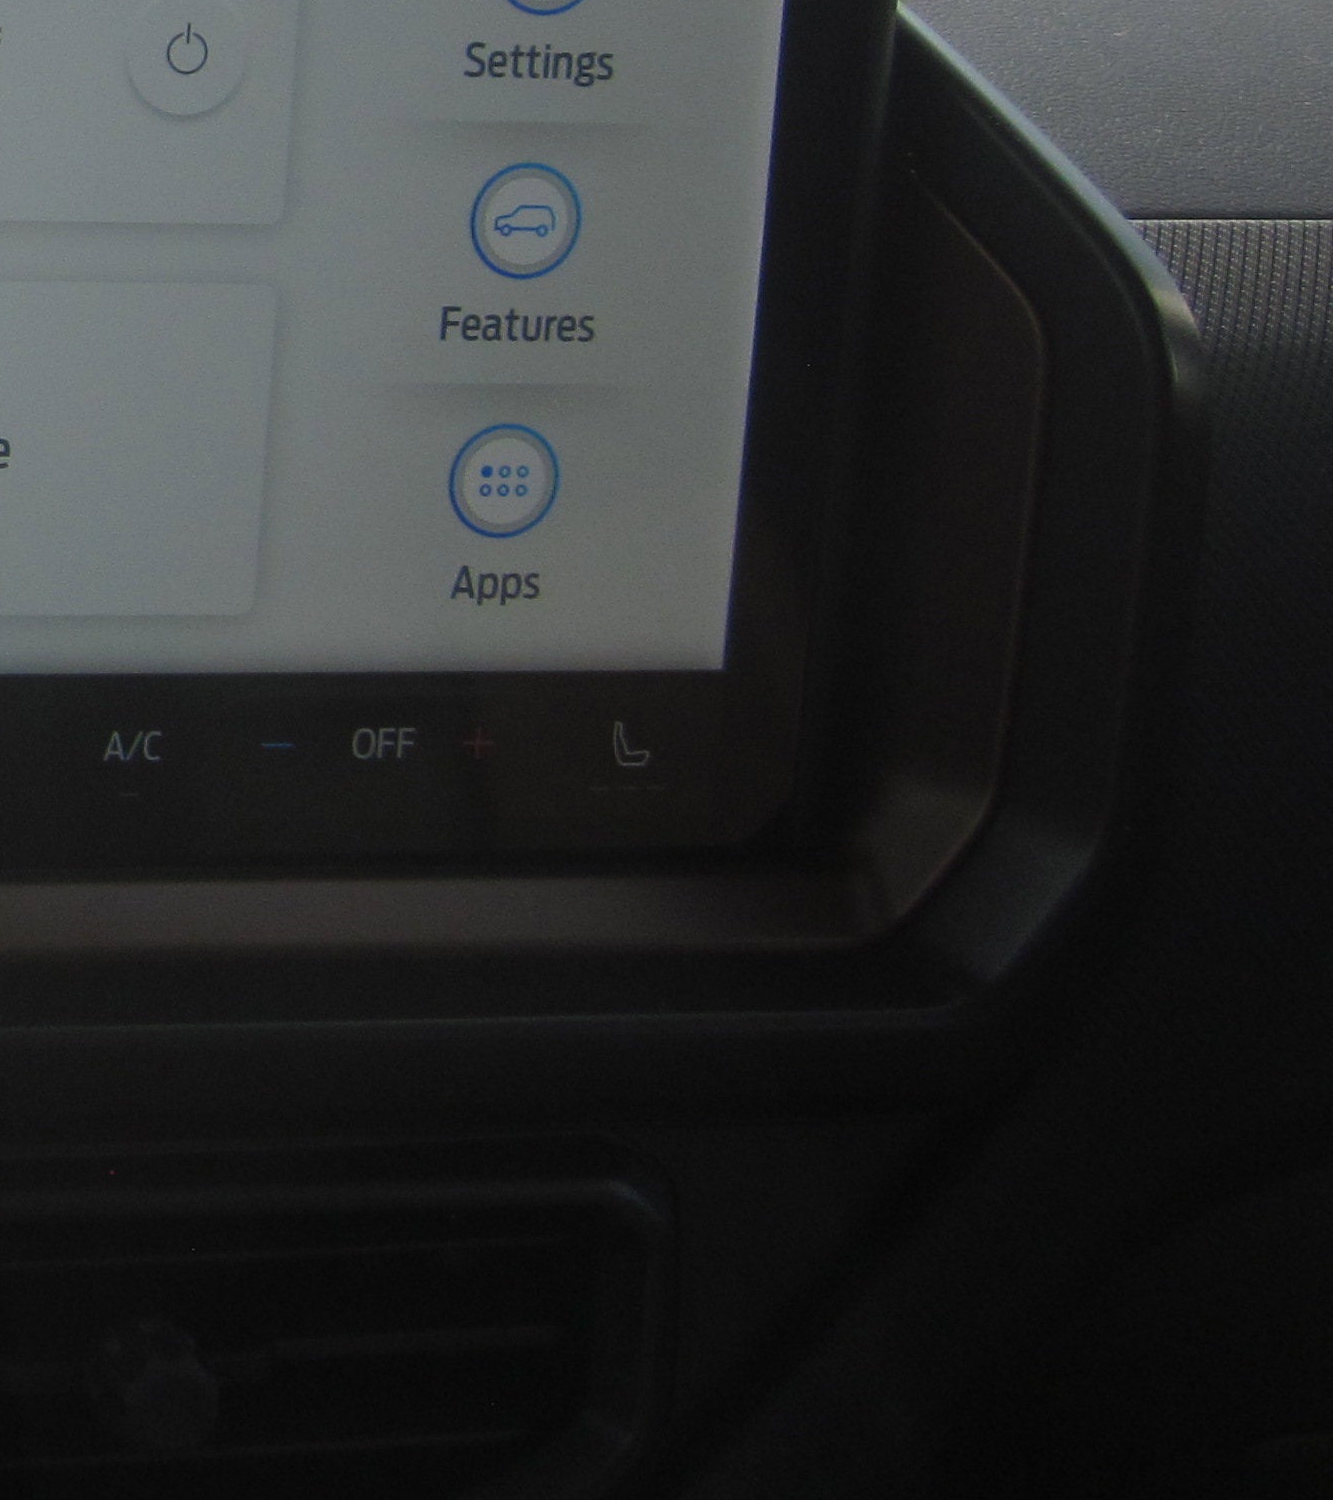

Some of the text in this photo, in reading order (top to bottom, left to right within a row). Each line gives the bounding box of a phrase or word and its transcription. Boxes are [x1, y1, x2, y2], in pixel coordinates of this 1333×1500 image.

[463, 40, 615, 88] Settings
[438, 304, 597, 344] Features
[449, 564, 542, 607] Apps
[102, 729, 163, 763] A/C
[350, 726, 416, 761] OFF
